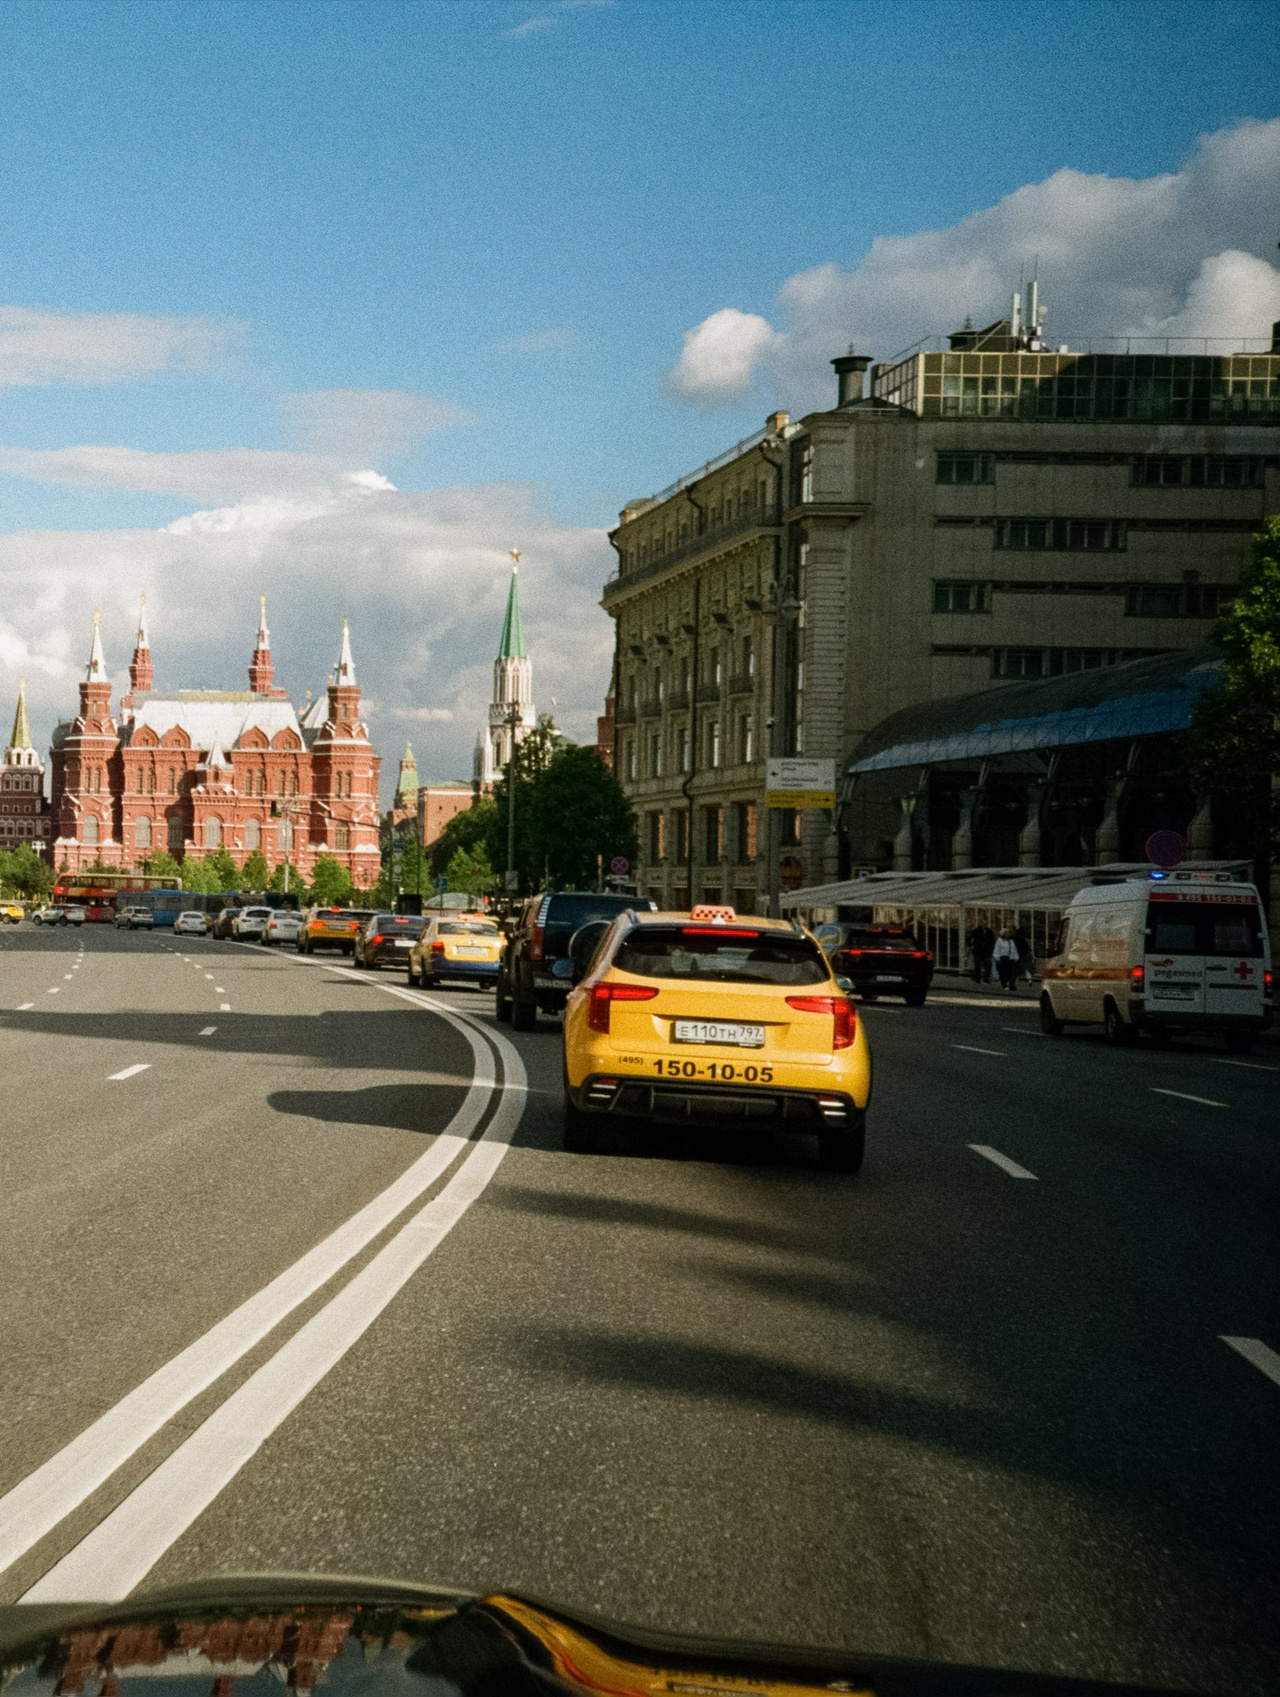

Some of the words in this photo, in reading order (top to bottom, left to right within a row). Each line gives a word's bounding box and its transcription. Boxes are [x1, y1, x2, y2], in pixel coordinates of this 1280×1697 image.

[1154, 969, 1203, 979] pegasmed
[618, 1056, 644, 1065] (495)
[653, 1059, 774, 1083] 150-10-05
